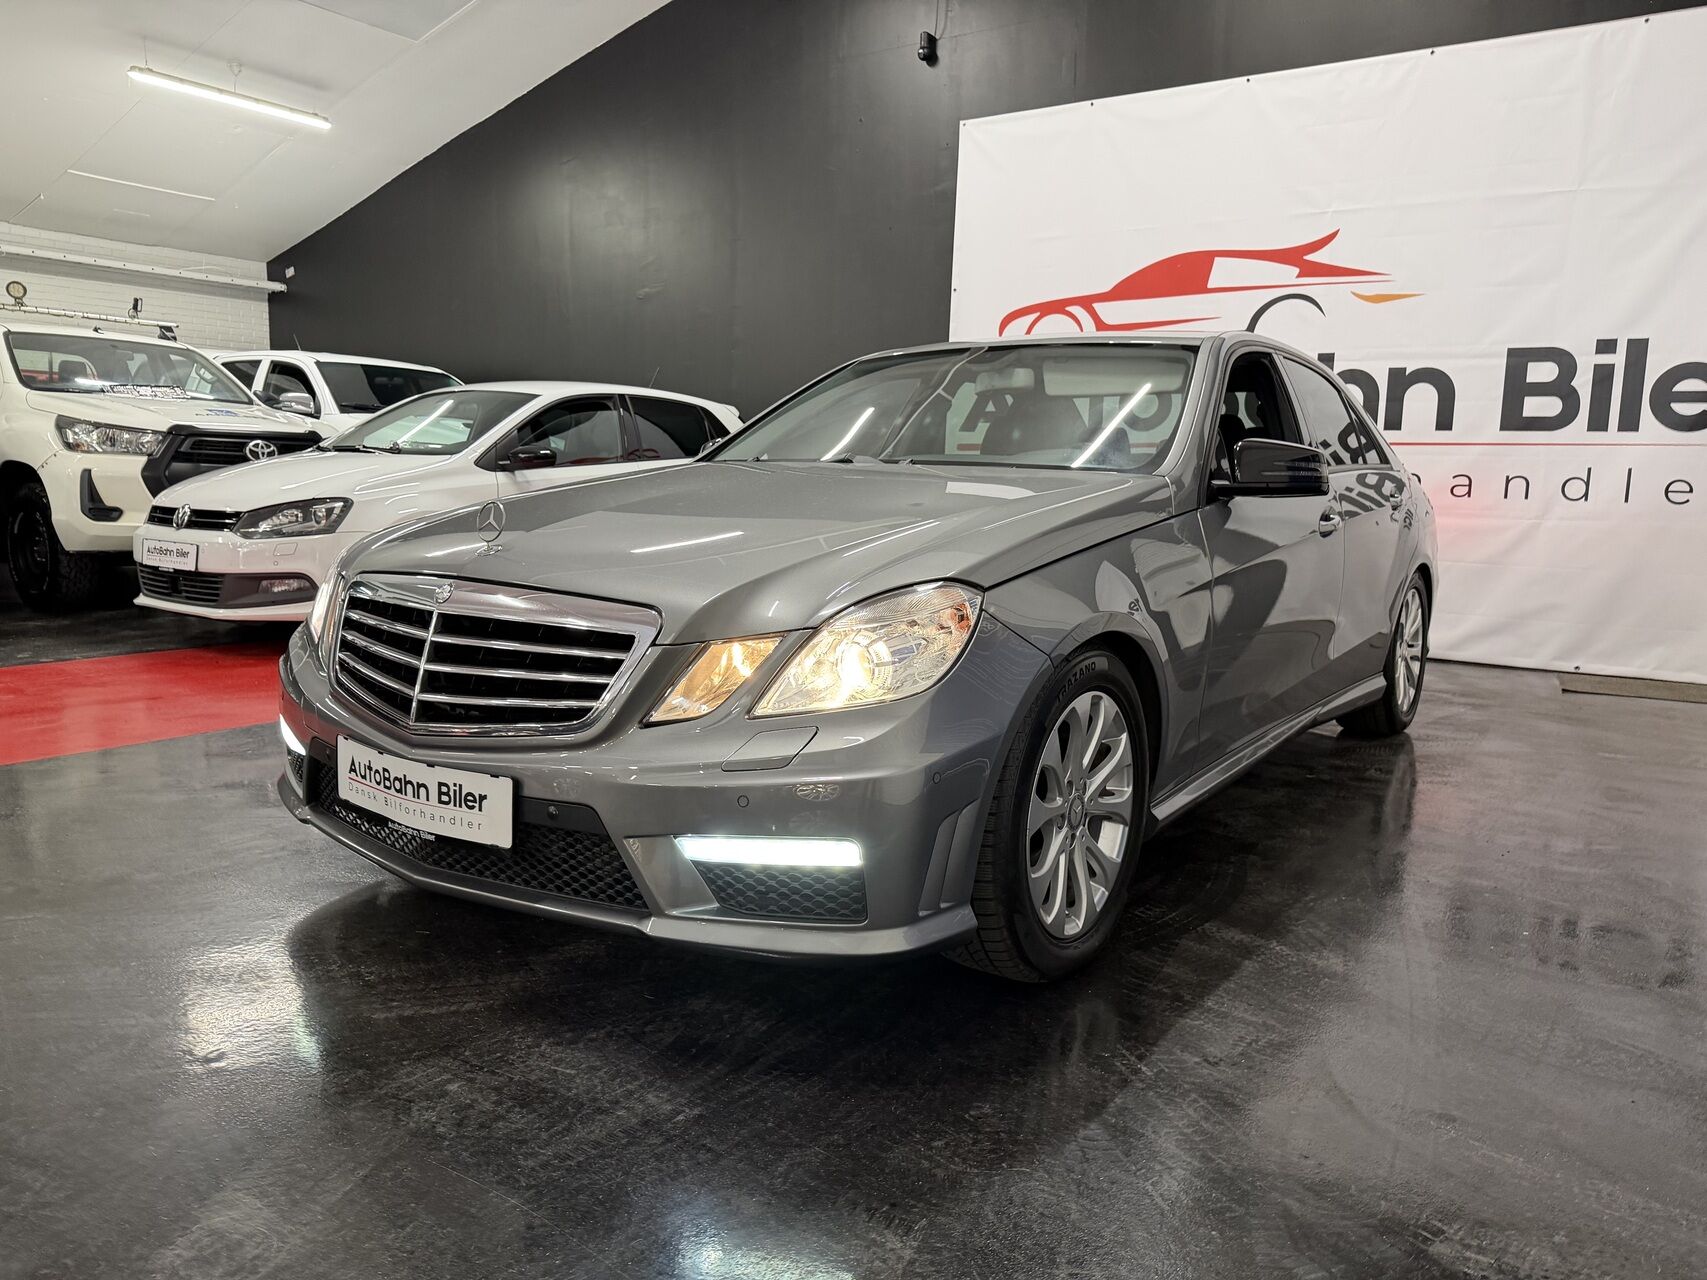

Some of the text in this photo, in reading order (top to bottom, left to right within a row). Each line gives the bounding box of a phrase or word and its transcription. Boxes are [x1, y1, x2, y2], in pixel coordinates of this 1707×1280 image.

[1411, 466, 1695, 506] andle
[1056, 661, 1097, 704] TRAZANO
[348, 756, 488, 812] AutoBahn Biler
[348, 782, 482, 831] Dansk Bilforhandler
